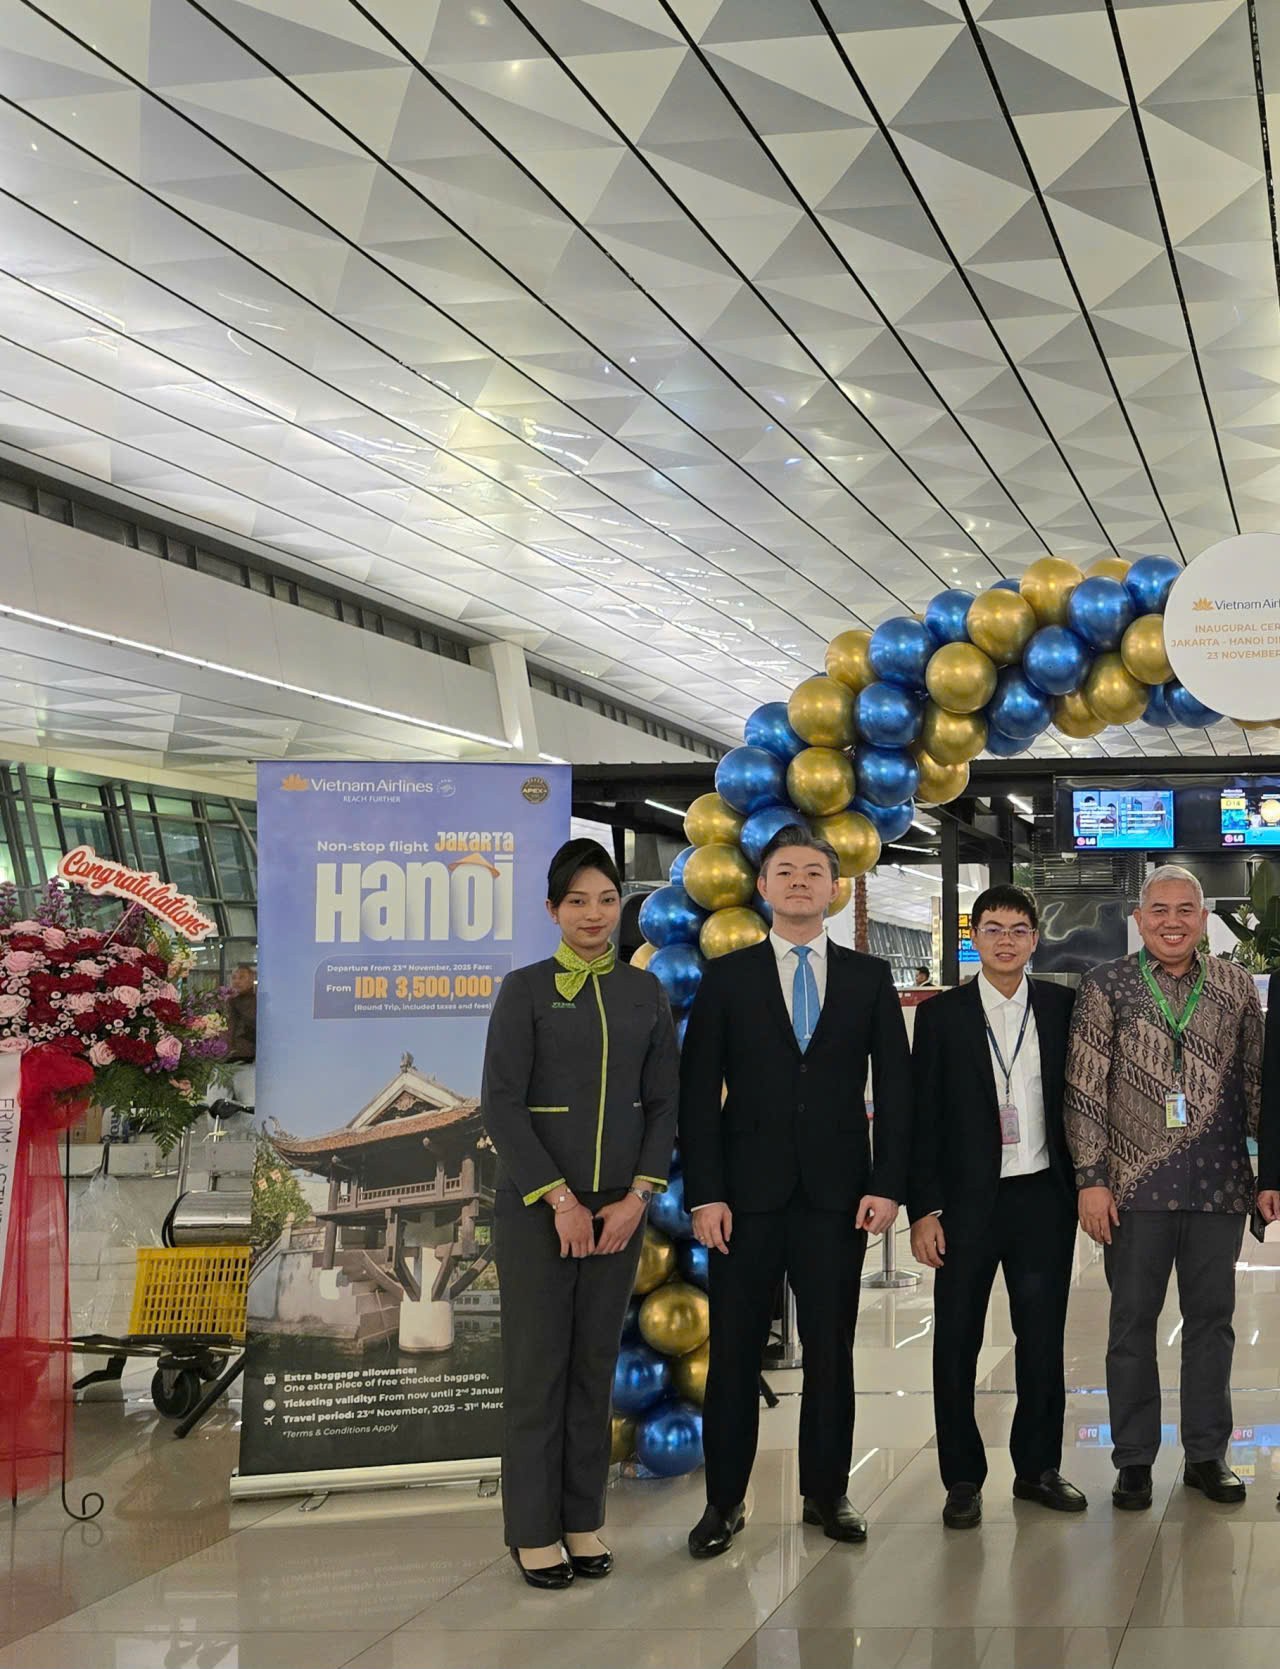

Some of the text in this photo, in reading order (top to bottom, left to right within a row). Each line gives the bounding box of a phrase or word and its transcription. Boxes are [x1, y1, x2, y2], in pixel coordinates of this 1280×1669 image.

[1215, 599, 1261, 610] Vietnam
[1195, 623, 1257, 633] INAUGURAL
[1171, 638, 1220, 648] JAKARTA
[1229, 637, 1264, 646] HANOI
[1207, 651, 1218, 659] 23
[310, 778, 433, 793] Vietnam Airlines
[317, 841, 385, 854] Non-stop
[389, 840, 429, 854] flight
[63, 850, 210, 936] Congratulations
[327, 964, 368, 974] Departure
[370, 964, 390, 972] from
[326, 984, 352, 993] From
[355, 976, 388, 998] IDR
[284, 1366, 417, 1383] Extra baggage allowance:
[284, 1384, 305, 1393] One
[307, 1383, 333, 1391] extra
[335, 1380, 362, 1392] piece
[364, 1378, 376, 1388] of
[377, 1378, 398, 1387] free
[400, 1375, 441, 1385] checked
[283, 1397, 333, 1410] Ticketing
[335, 1394, 377, 1407] validity:
[379, 1393, 404, 1402] From
[407, 1392, 428, 1400] now
[431, 1389, 453, 1398] until
[471, 1386, 504, 1396] Januar
[283, 1413, 315, 1424] Travel
[317, 1411, 355, 1425] period:
[376, 1405, 430, 1418] November,
[432, 1403, 455, 1413] 2025
[481, 1401, 504, 1410] Marc
[315, 1428, 322, 1437] &
[323, 1424, 370, 1437] Conditions
[372, 1423, 399, 1435] Apply
